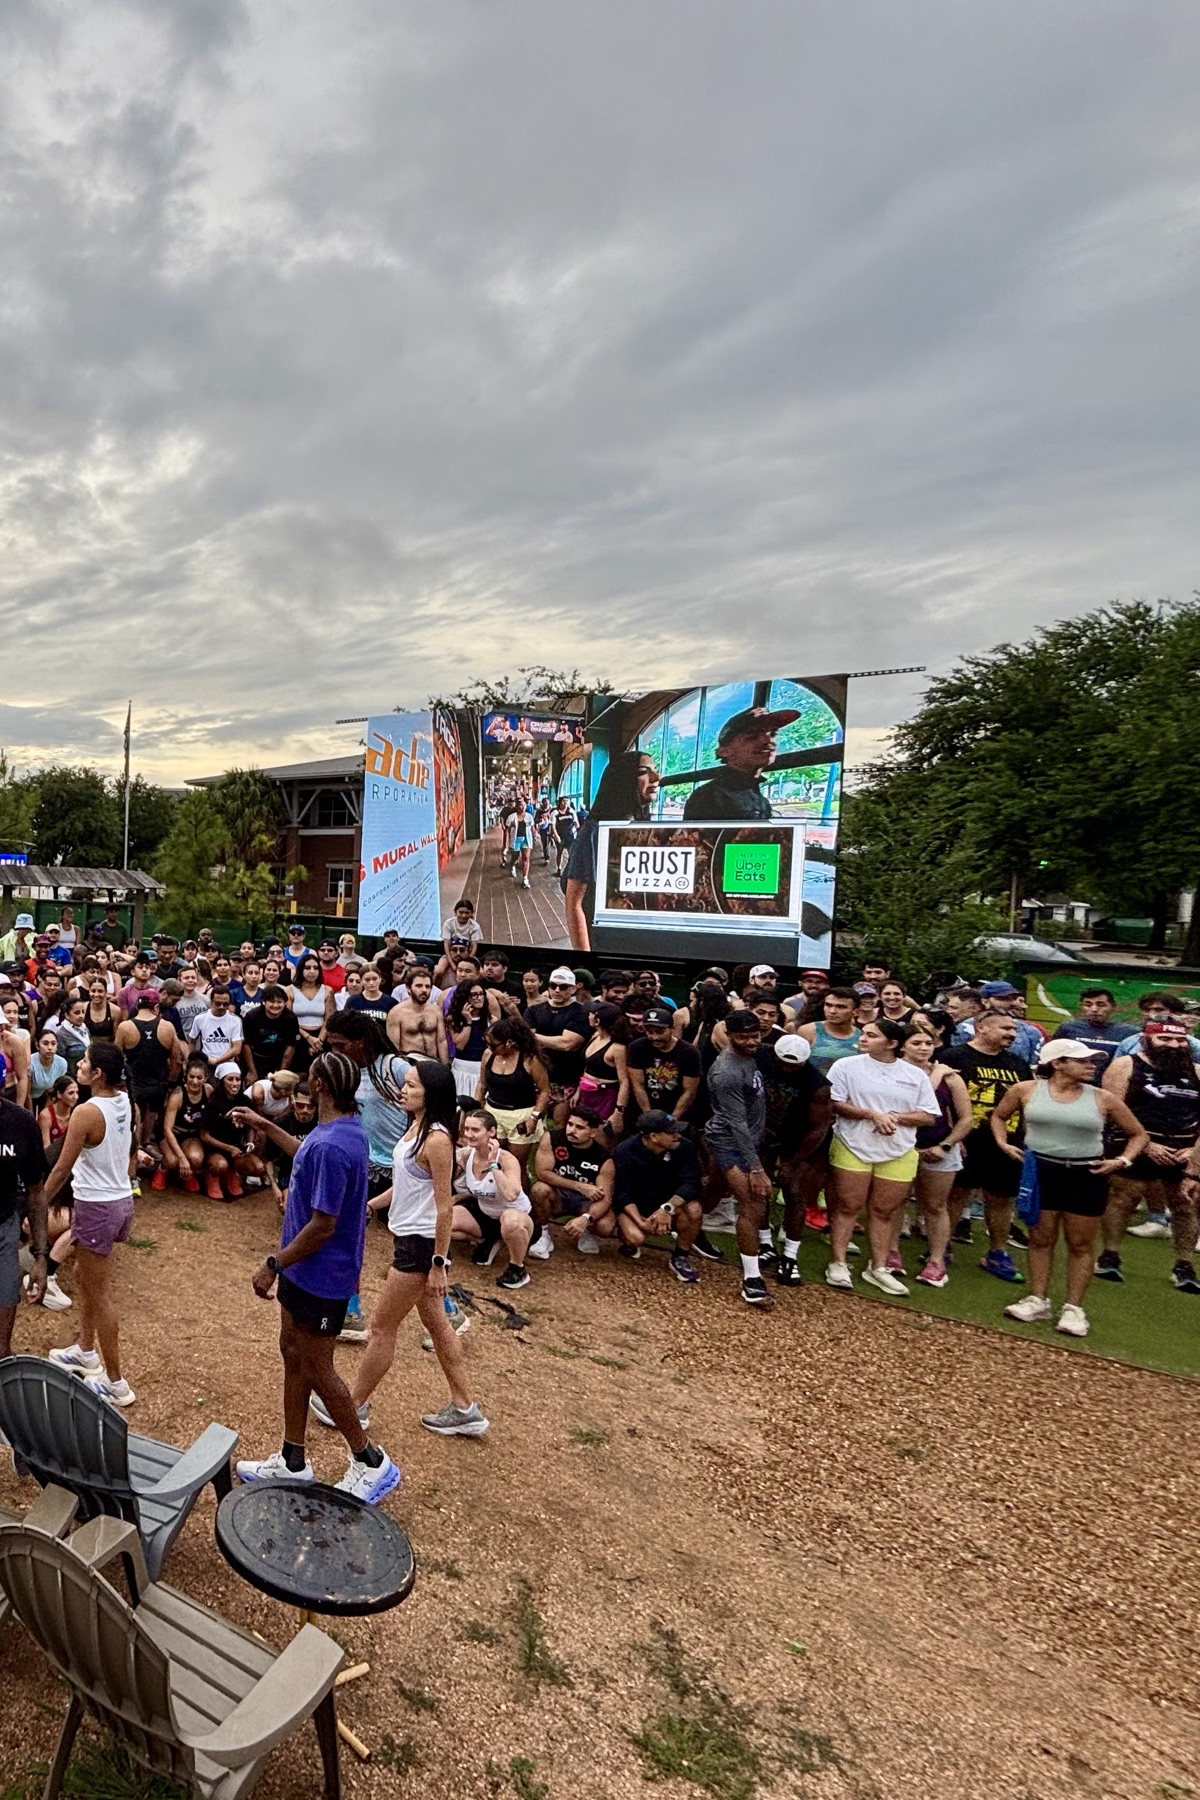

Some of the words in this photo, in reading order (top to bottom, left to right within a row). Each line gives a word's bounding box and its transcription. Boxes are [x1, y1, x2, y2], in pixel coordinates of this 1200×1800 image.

[372, 840, 419, 875] MURAL
[624, 851, 692, 875] CRUST
[735, 859, 767, 871] Uber
[735, 870, 766, 882] Eats
[624, 878, 672, 888] PIZZA
